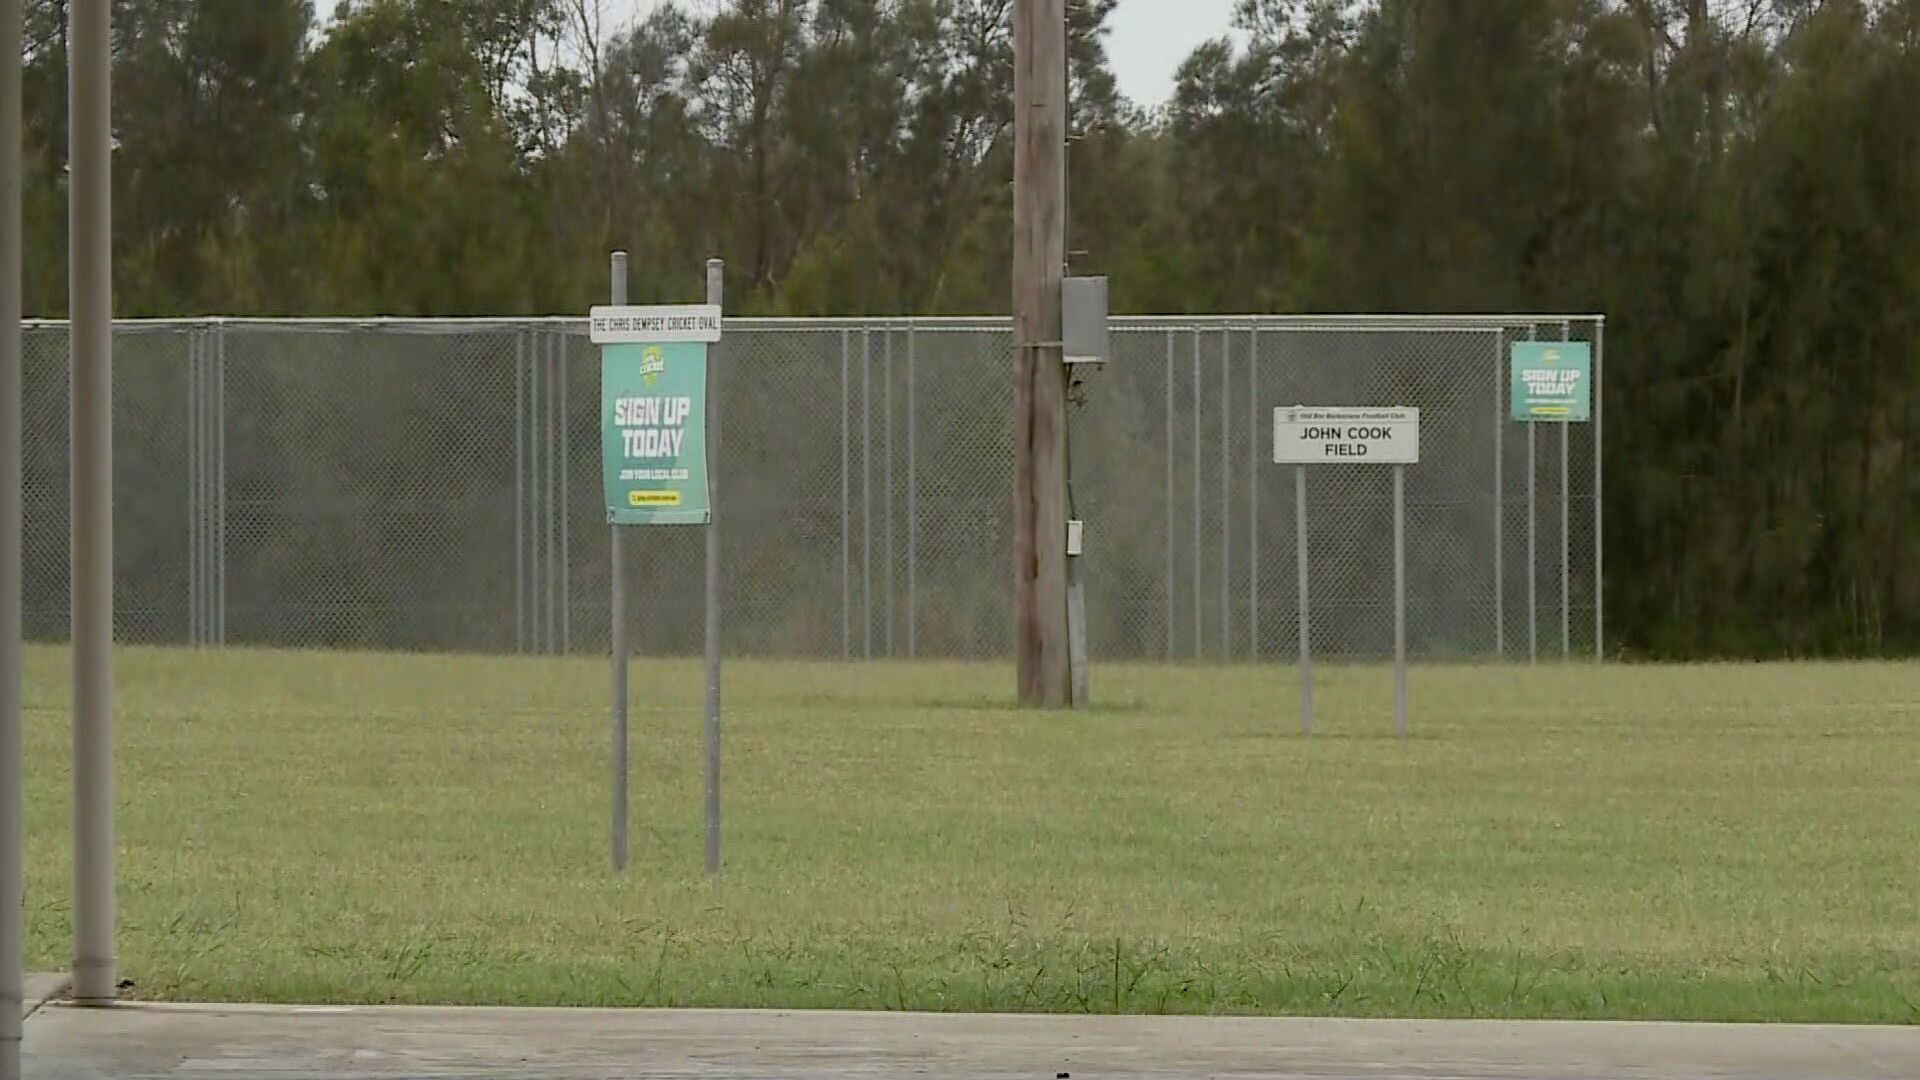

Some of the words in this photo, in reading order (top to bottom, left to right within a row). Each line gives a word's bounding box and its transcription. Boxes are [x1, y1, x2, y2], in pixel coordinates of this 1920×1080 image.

[593, 317, 606, 331] THE
[609, 317, 630, 331] CHRIS
[632, 317, 665, 331] DEMPSEY
[668, 316, 696, 330] CRICKET
[699, 316, 718, 330] OVAL
[1522, 369, 1558, 382] SIGN
[1559, 369, 1581, 382] UP
[1527, 382, 1576, 395] TODAY
[615, 397, 660, 426] SIGN
[663, 396, 691, 426] UP
[1300, 427, 1341, 440] JOHN
[1347, 427, 1392, 440] COOK
[622, 429, 684, 458] TODAY
[1325, 443, 1367, 456] FIELD
